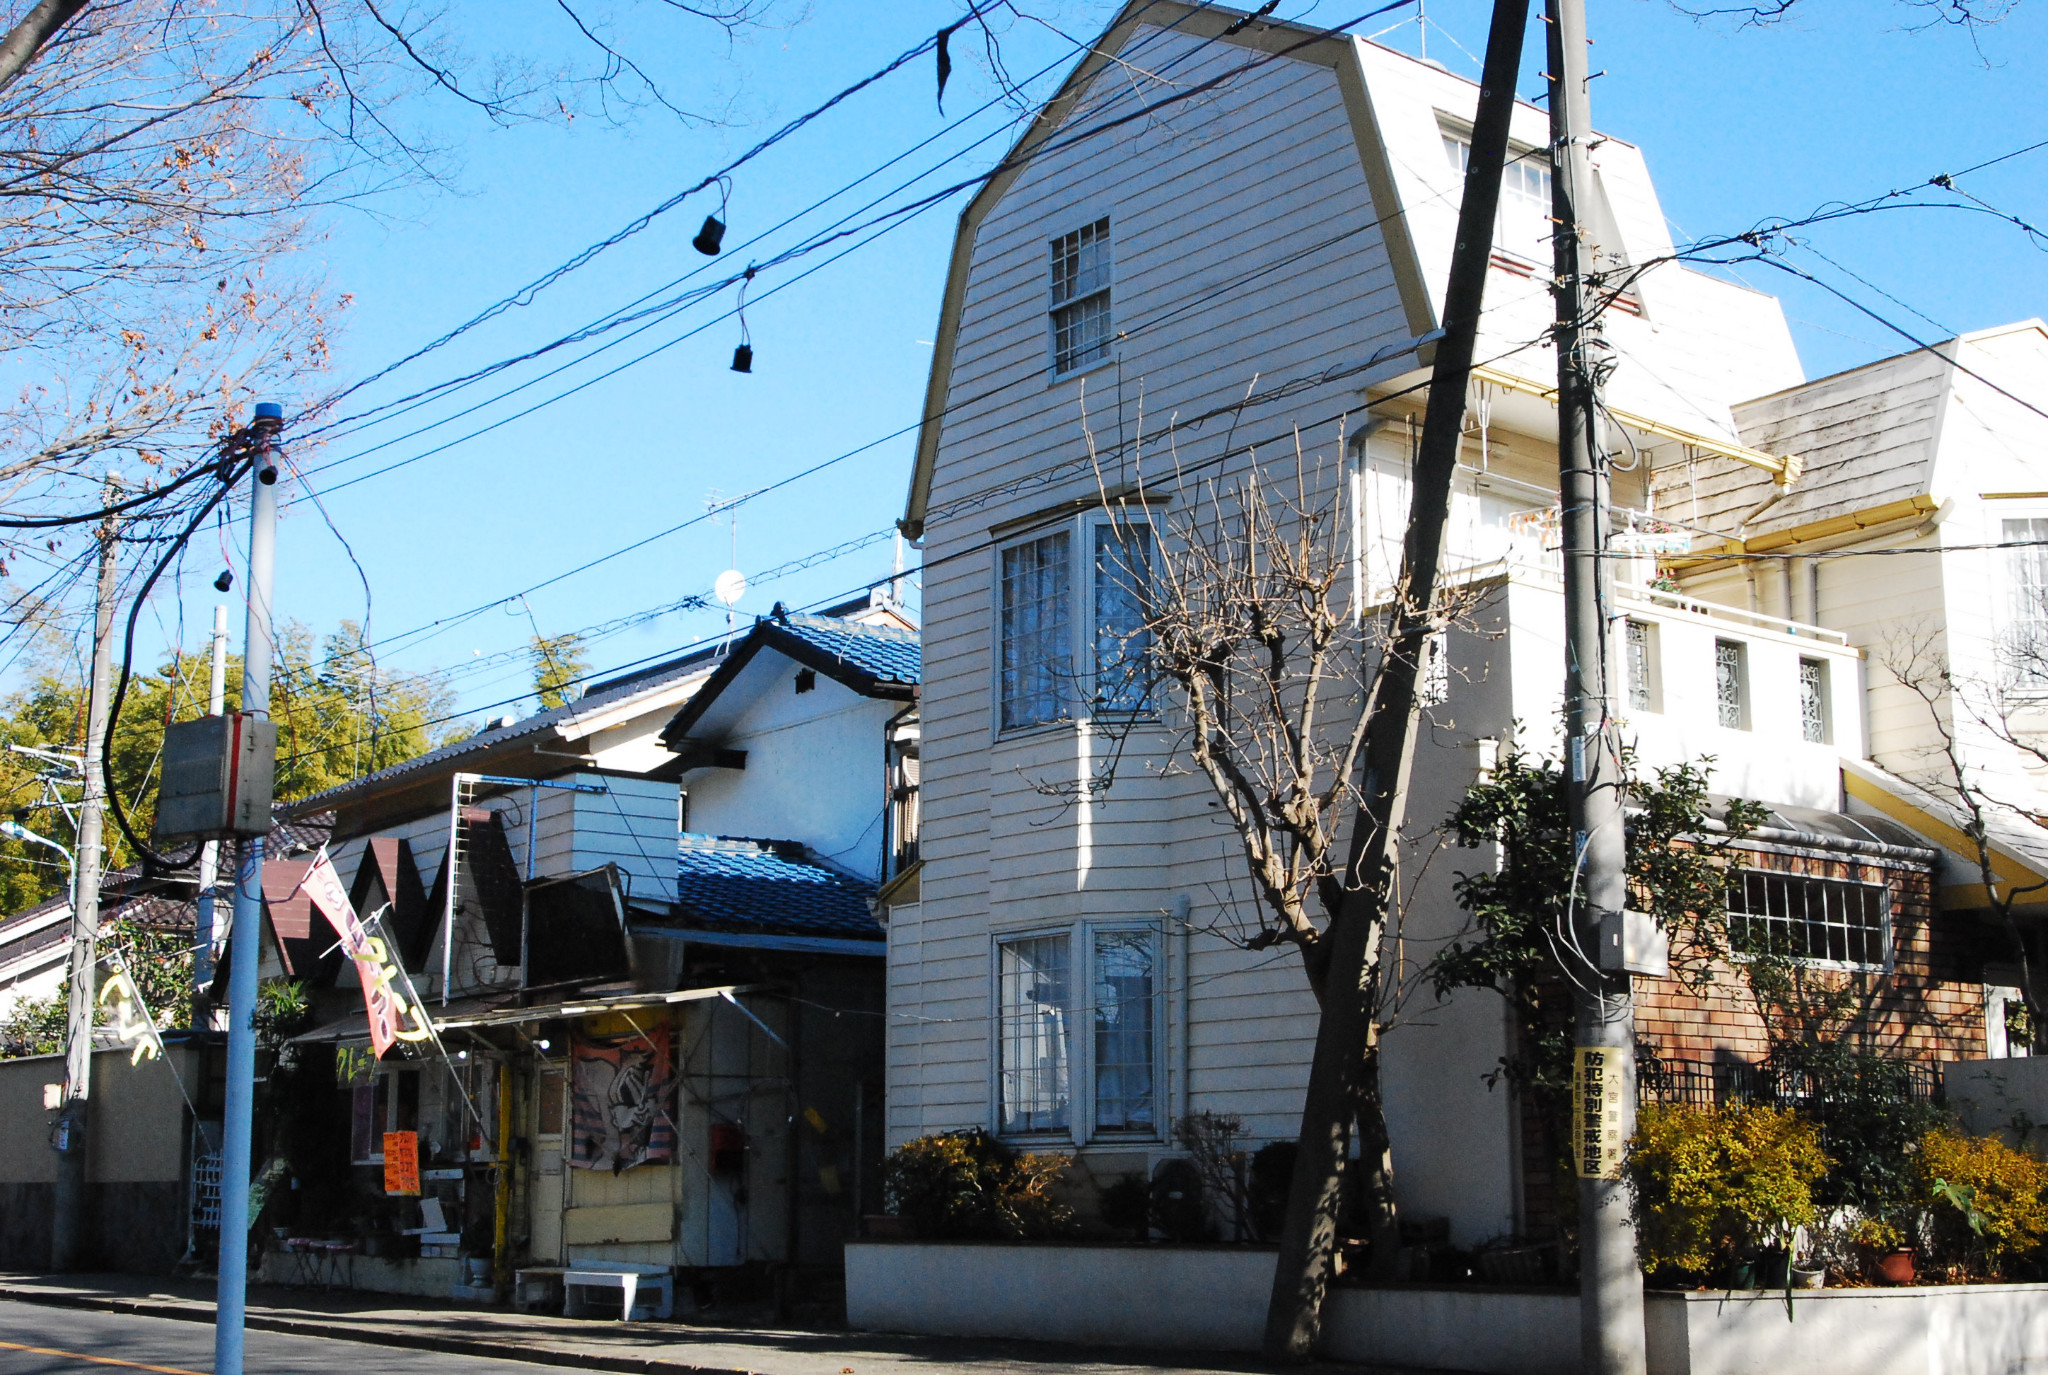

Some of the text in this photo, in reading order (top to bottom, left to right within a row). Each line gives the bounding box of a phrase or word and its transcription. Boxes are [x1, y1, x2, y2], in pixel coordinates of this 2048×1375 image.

[1584, 1051, 1604, 1174] 防犯特別警戒地区
